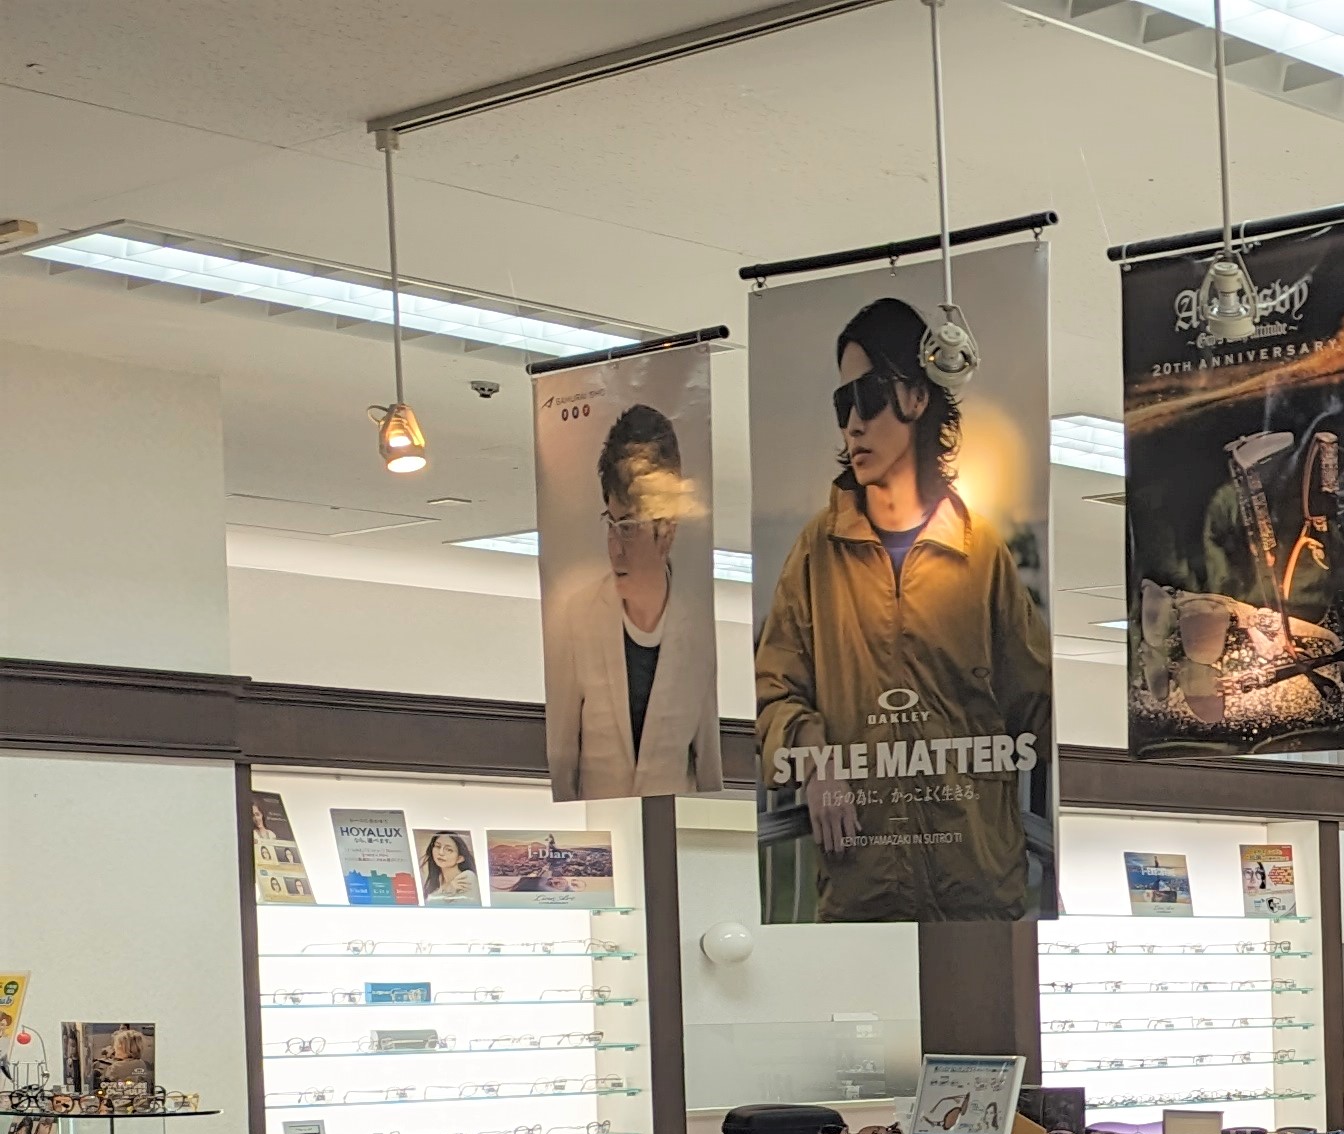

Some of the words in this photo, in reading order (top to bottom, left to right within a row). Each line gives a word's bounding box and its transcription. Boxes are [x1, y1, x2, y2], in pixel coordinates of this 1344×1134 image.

[1152, 362, 1192, 377] 20TH
[1198, 337, 1338, 370] ANNIVERSARY
[867, 710, 931, 726] OAKLEY
[772, 742, 869, 785] STYLE
[875, 731, 1039, 779] MATTERS
[339, 826, 403, 839] HOYALUX
[840, 833, 868, 848] KENTO
[868, 833, 912, 847] YAMAZAKI
[912, 833, 923, 845] IN
[923, 832, 953, 846] SUTRO
